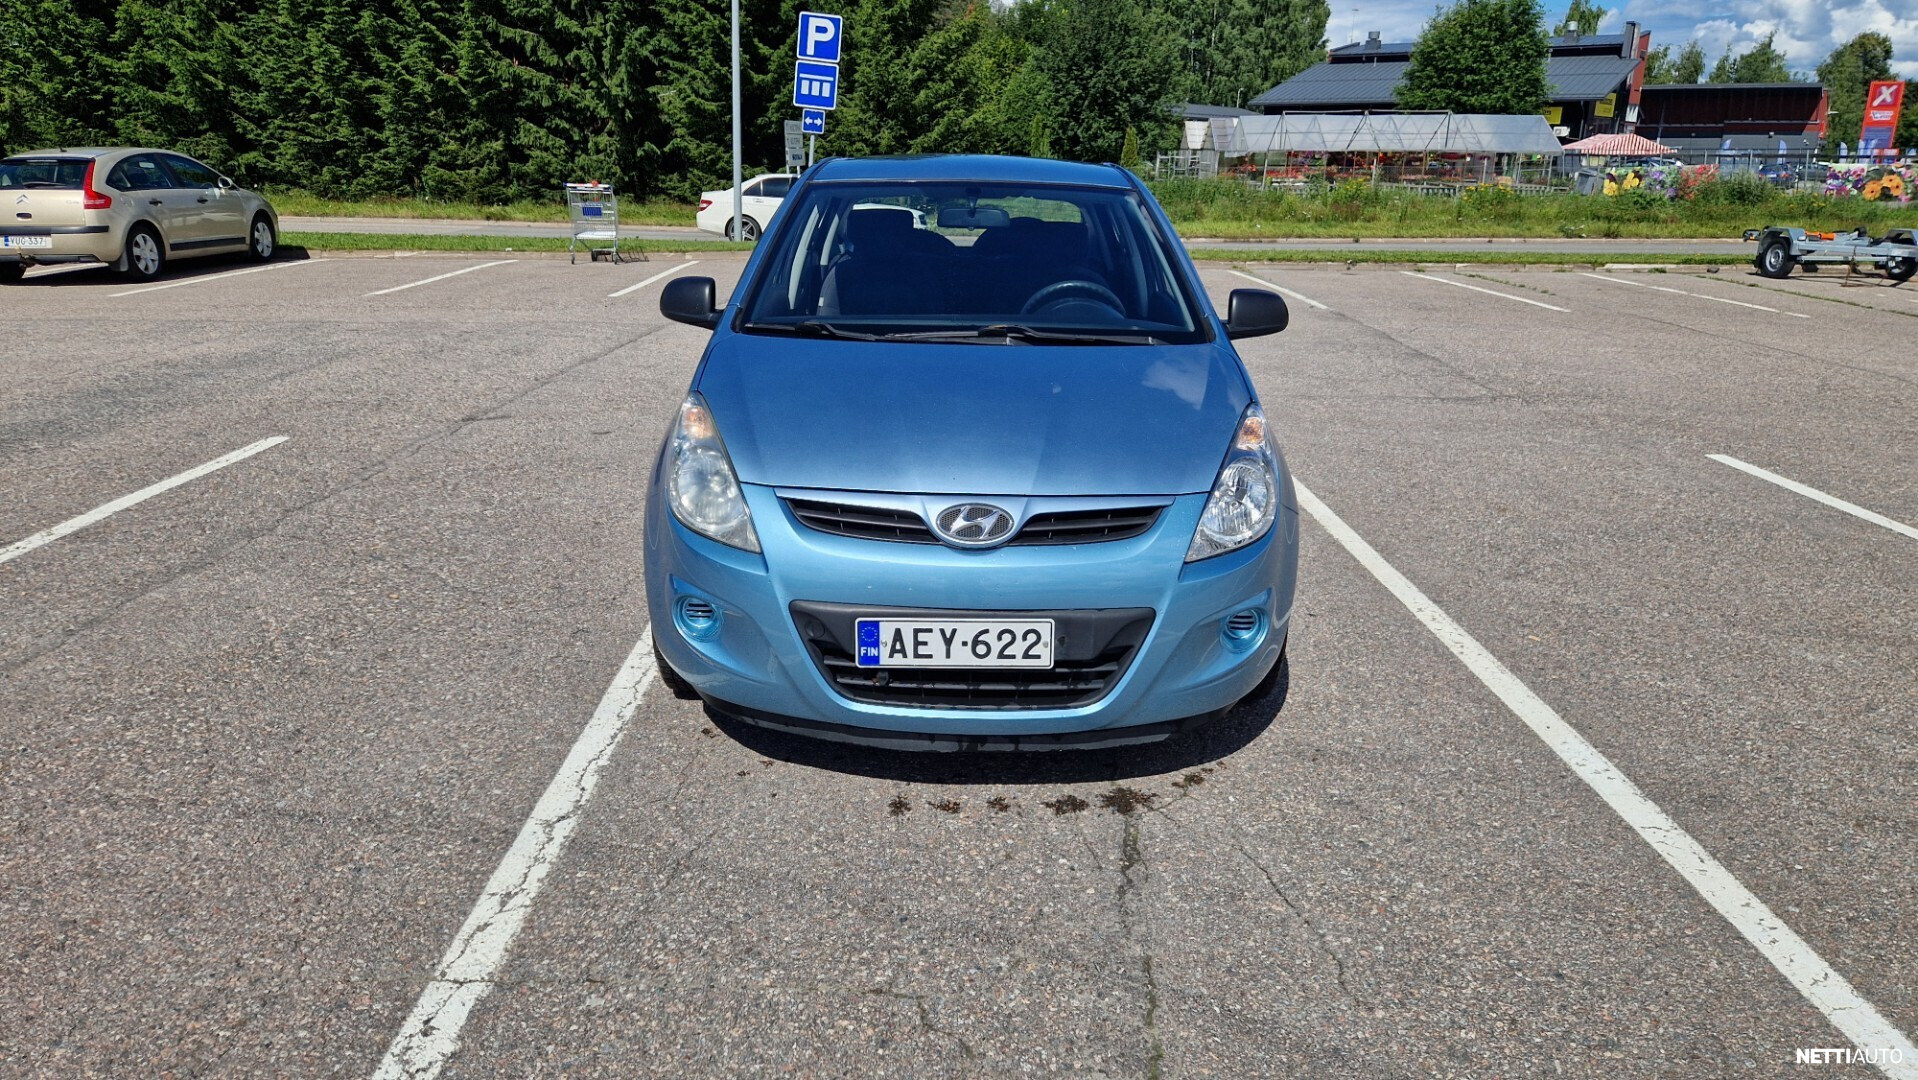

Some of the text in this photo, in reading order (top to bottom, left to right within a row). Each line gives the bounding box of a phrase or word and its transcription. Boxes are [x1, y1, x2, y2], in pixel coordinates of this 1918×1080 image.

[806, 16, 836, 56] P
[860, 627, 1042, 660] FIN AEY-622
